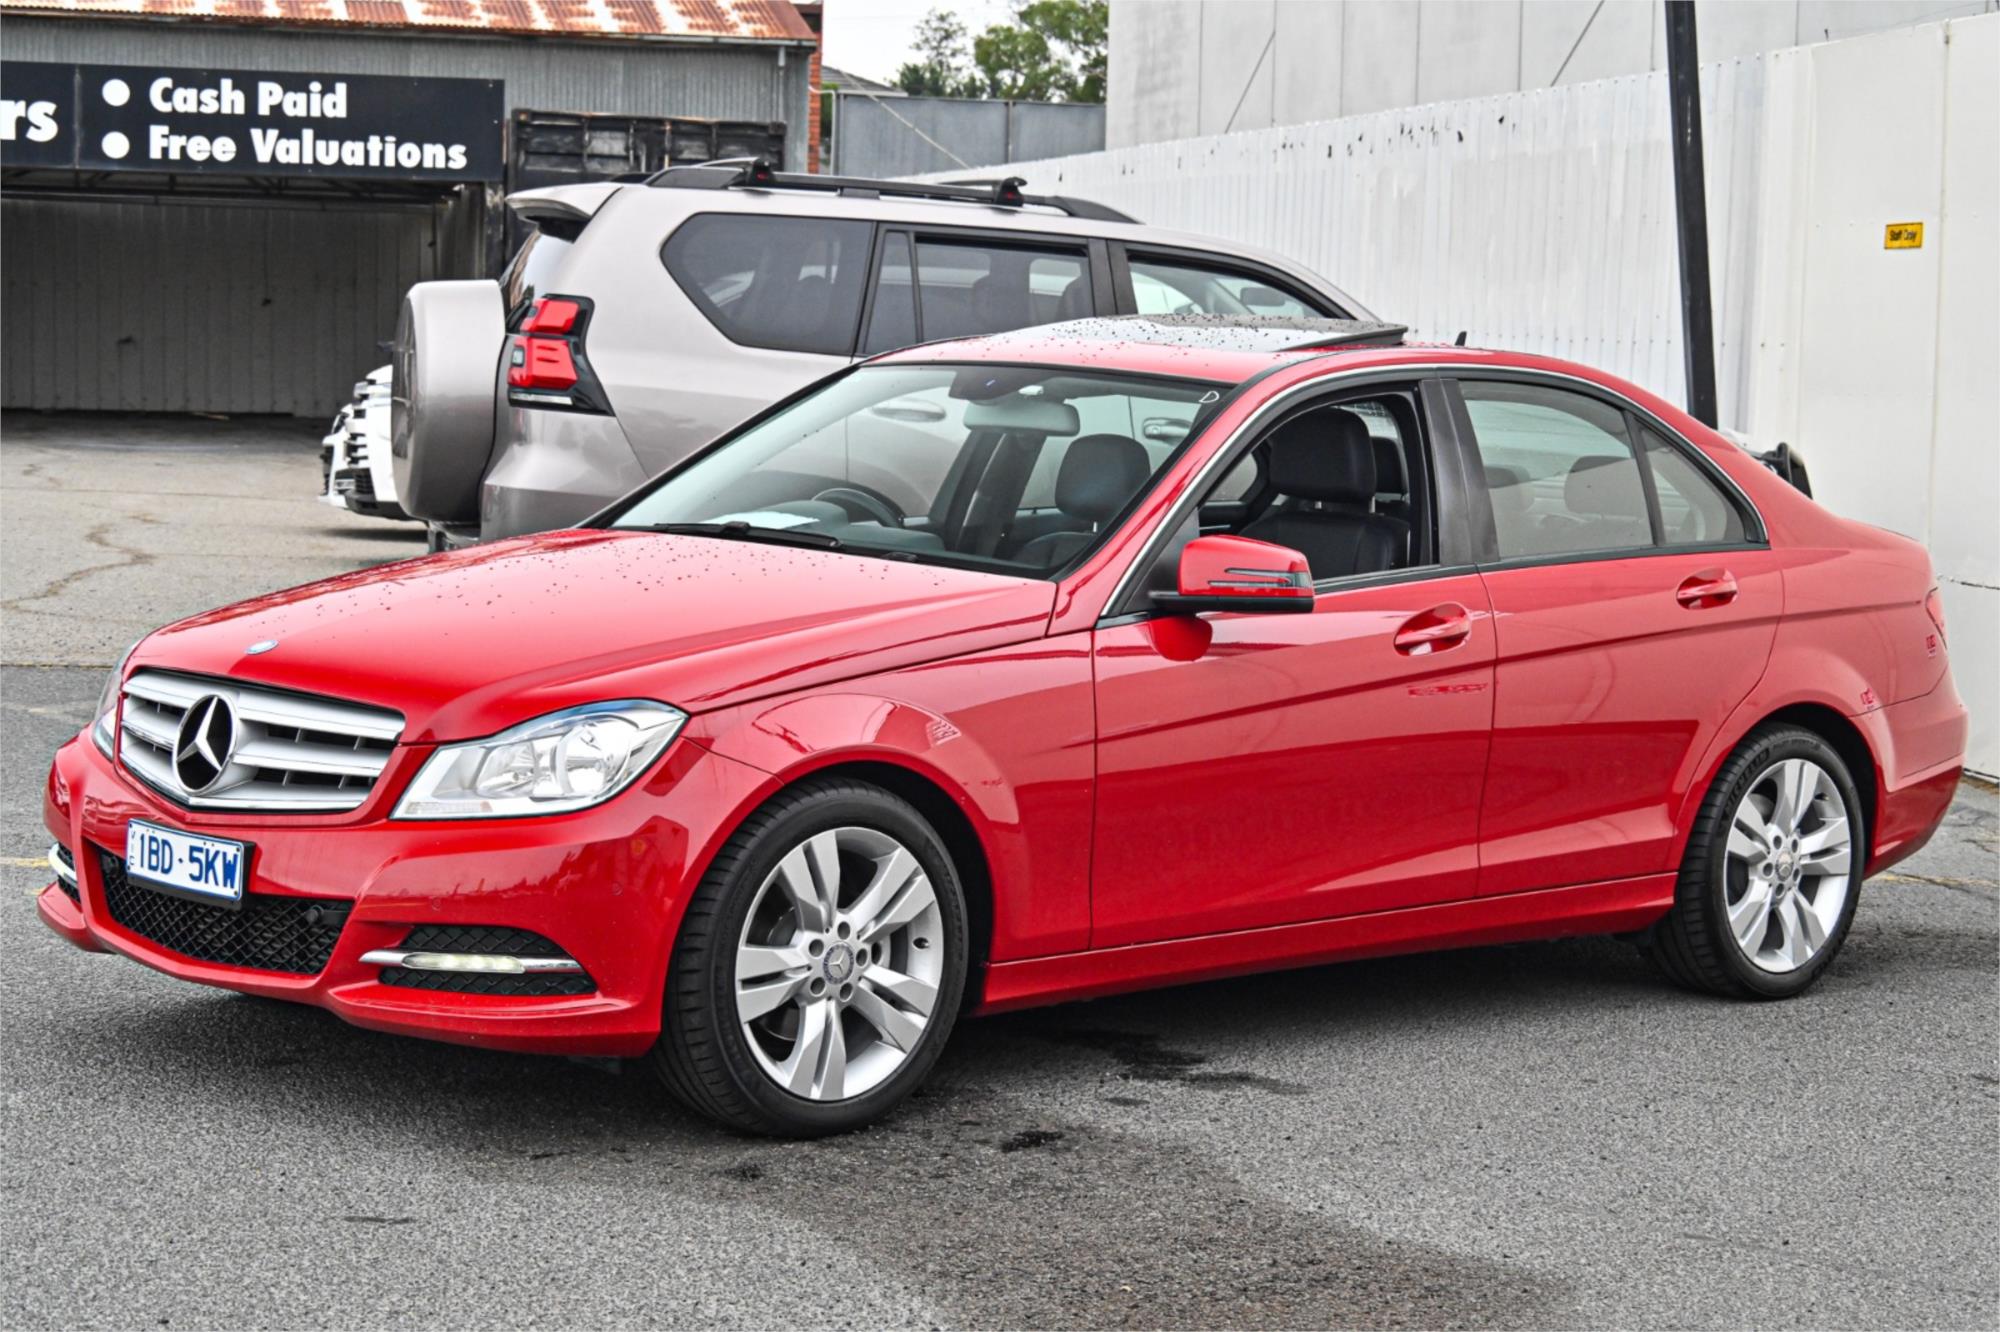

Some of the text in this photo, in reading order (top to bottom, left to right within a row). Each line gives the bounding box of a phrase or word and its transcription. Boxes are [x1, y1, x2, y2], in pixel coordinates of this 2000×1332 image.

[150, 77, 347, 118] Cash Paid
[150, 125, 467, 169] Free Valuations
